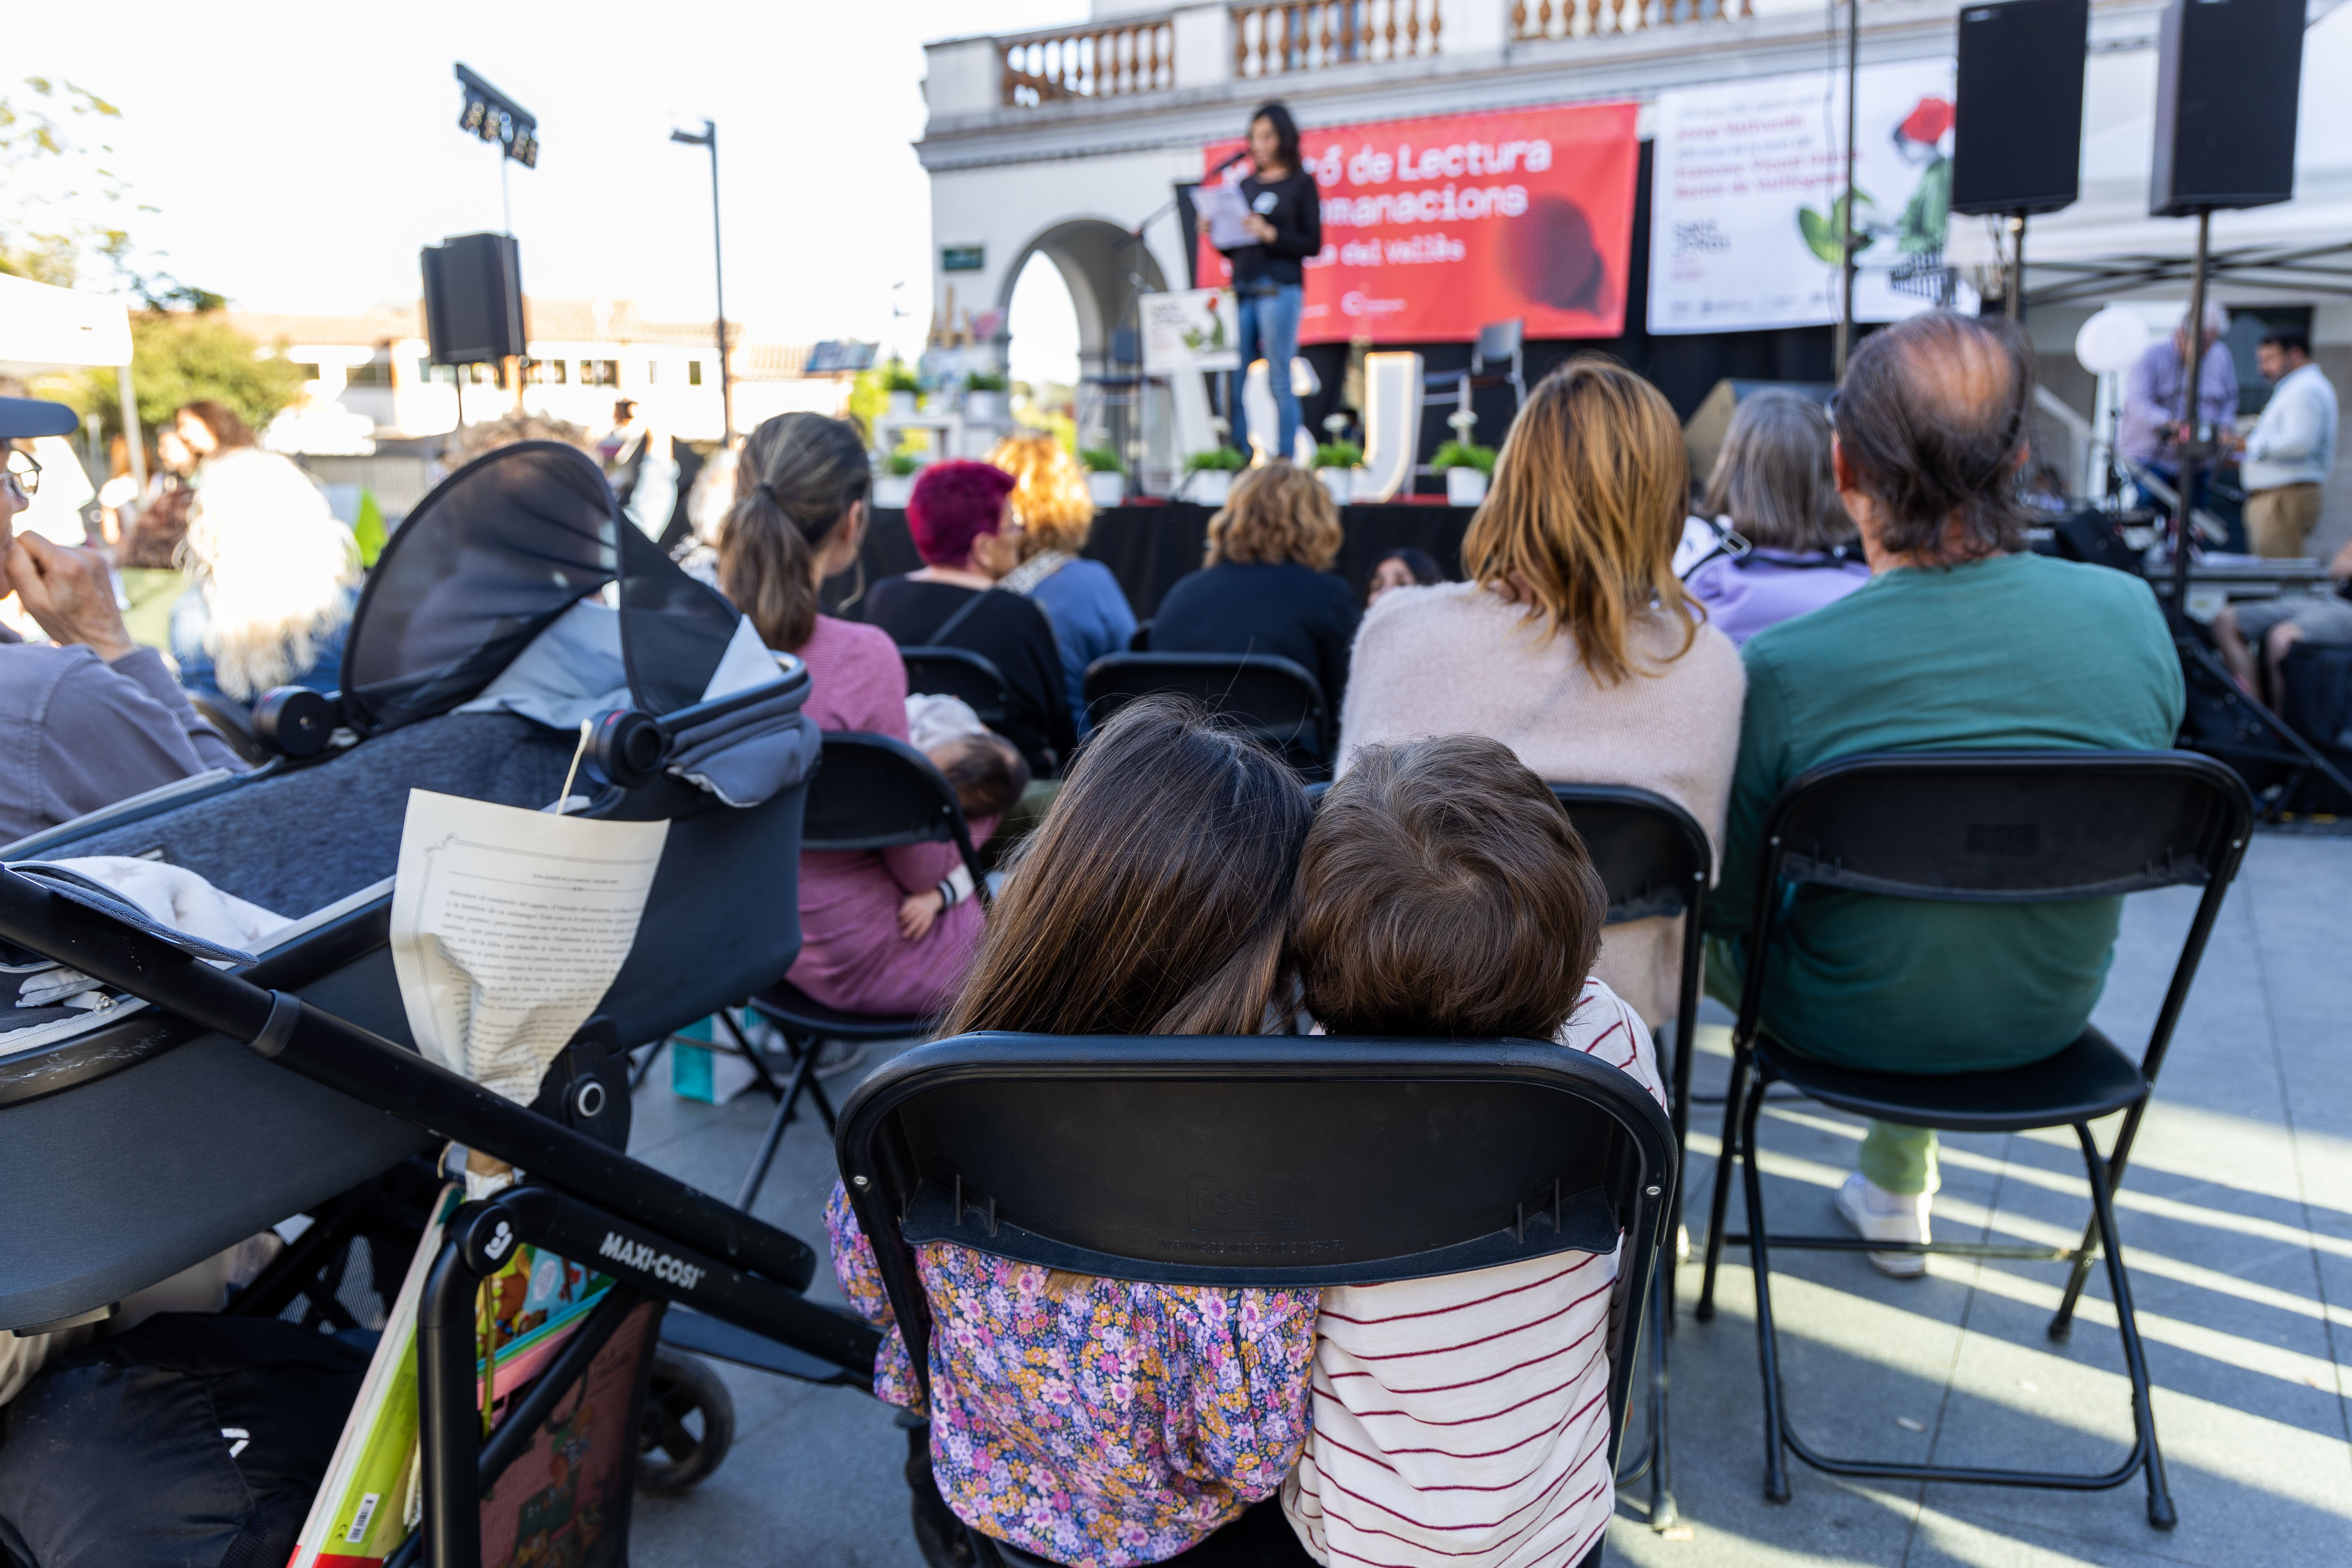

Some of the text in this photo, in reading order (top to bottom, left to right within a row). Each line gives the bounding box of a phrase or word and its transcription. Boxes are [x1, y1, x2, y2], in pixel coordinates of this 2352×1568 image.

[1347, 143, 1394, 186] de
[1397, 139, 1552, 182] Lectura
[1319, 181, 1528, 227] manacions
[1196, 1182, 1299, 1215] resol
[1229, 1243, 1250, 1256] NOT
[1252, 1242, 1286, 1255] STAND
[1290, 1241, 1307, 1255] ON
